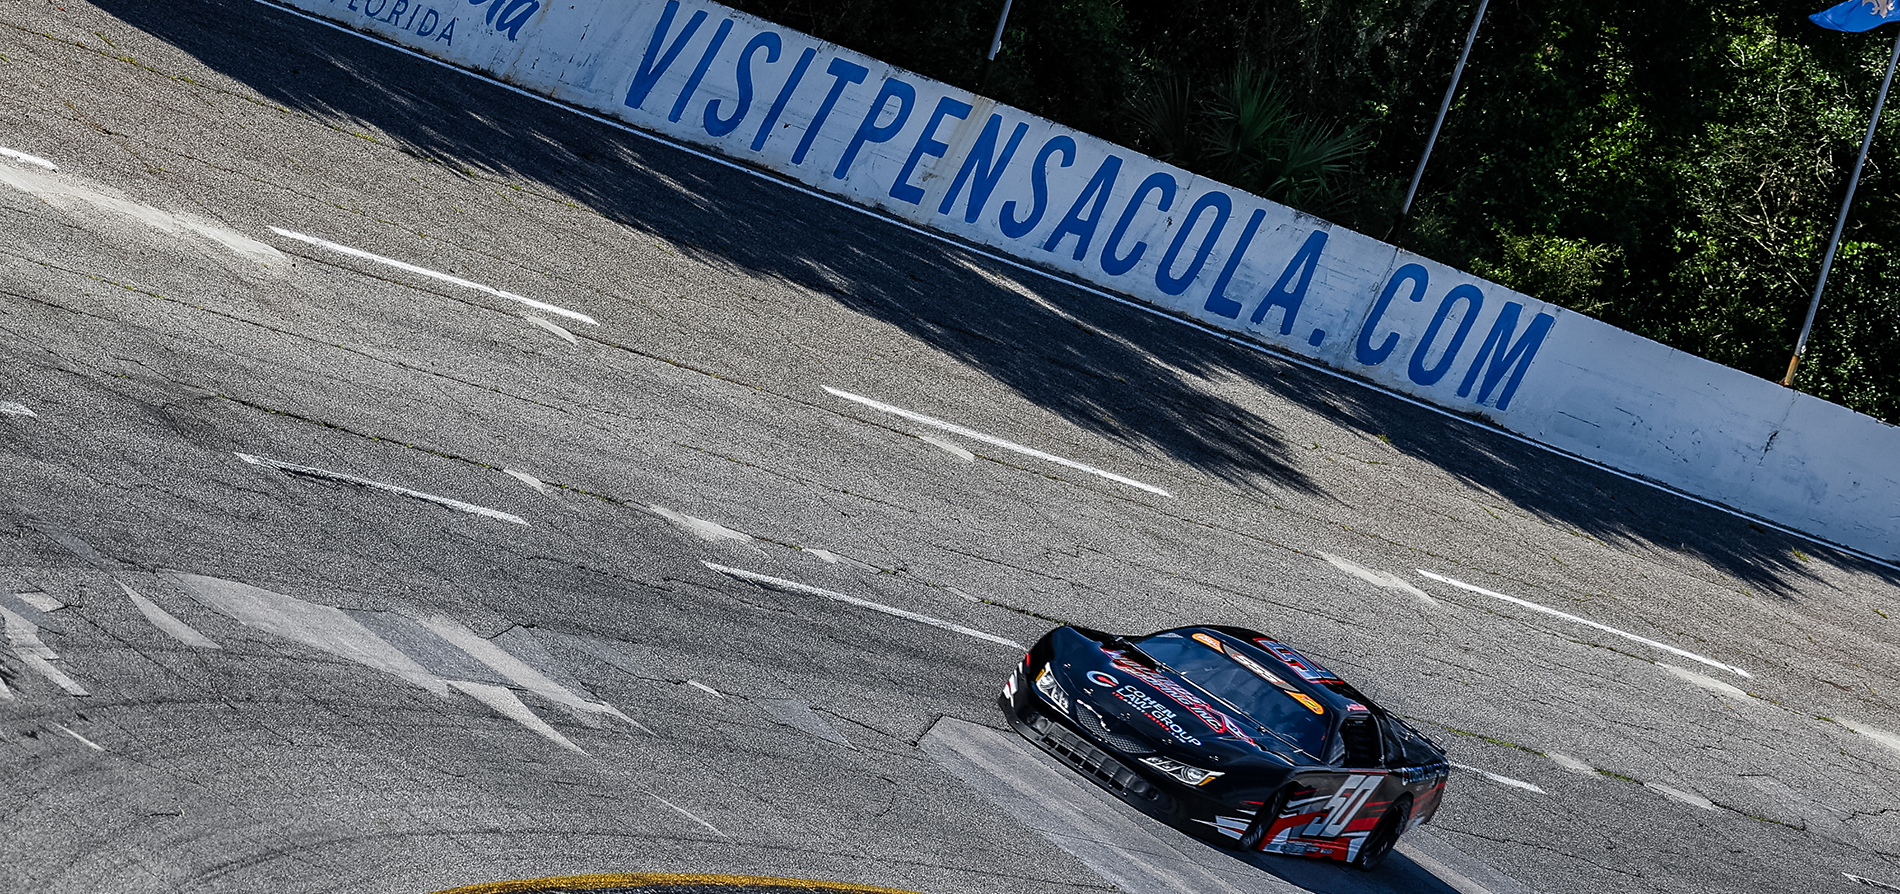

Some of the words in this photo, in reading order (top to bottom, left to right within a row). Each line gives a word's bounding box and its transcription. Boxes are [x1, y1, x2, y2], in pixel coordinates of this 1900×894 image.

[330, 0, 457, 46] ORIDA
[1115, 687, 1151, 710] LAW
[1151, 709, 1202, 746] GROUP
[1123, 684, 1178, 719] COHEN
[1301, 774, 1385, 837] 50
